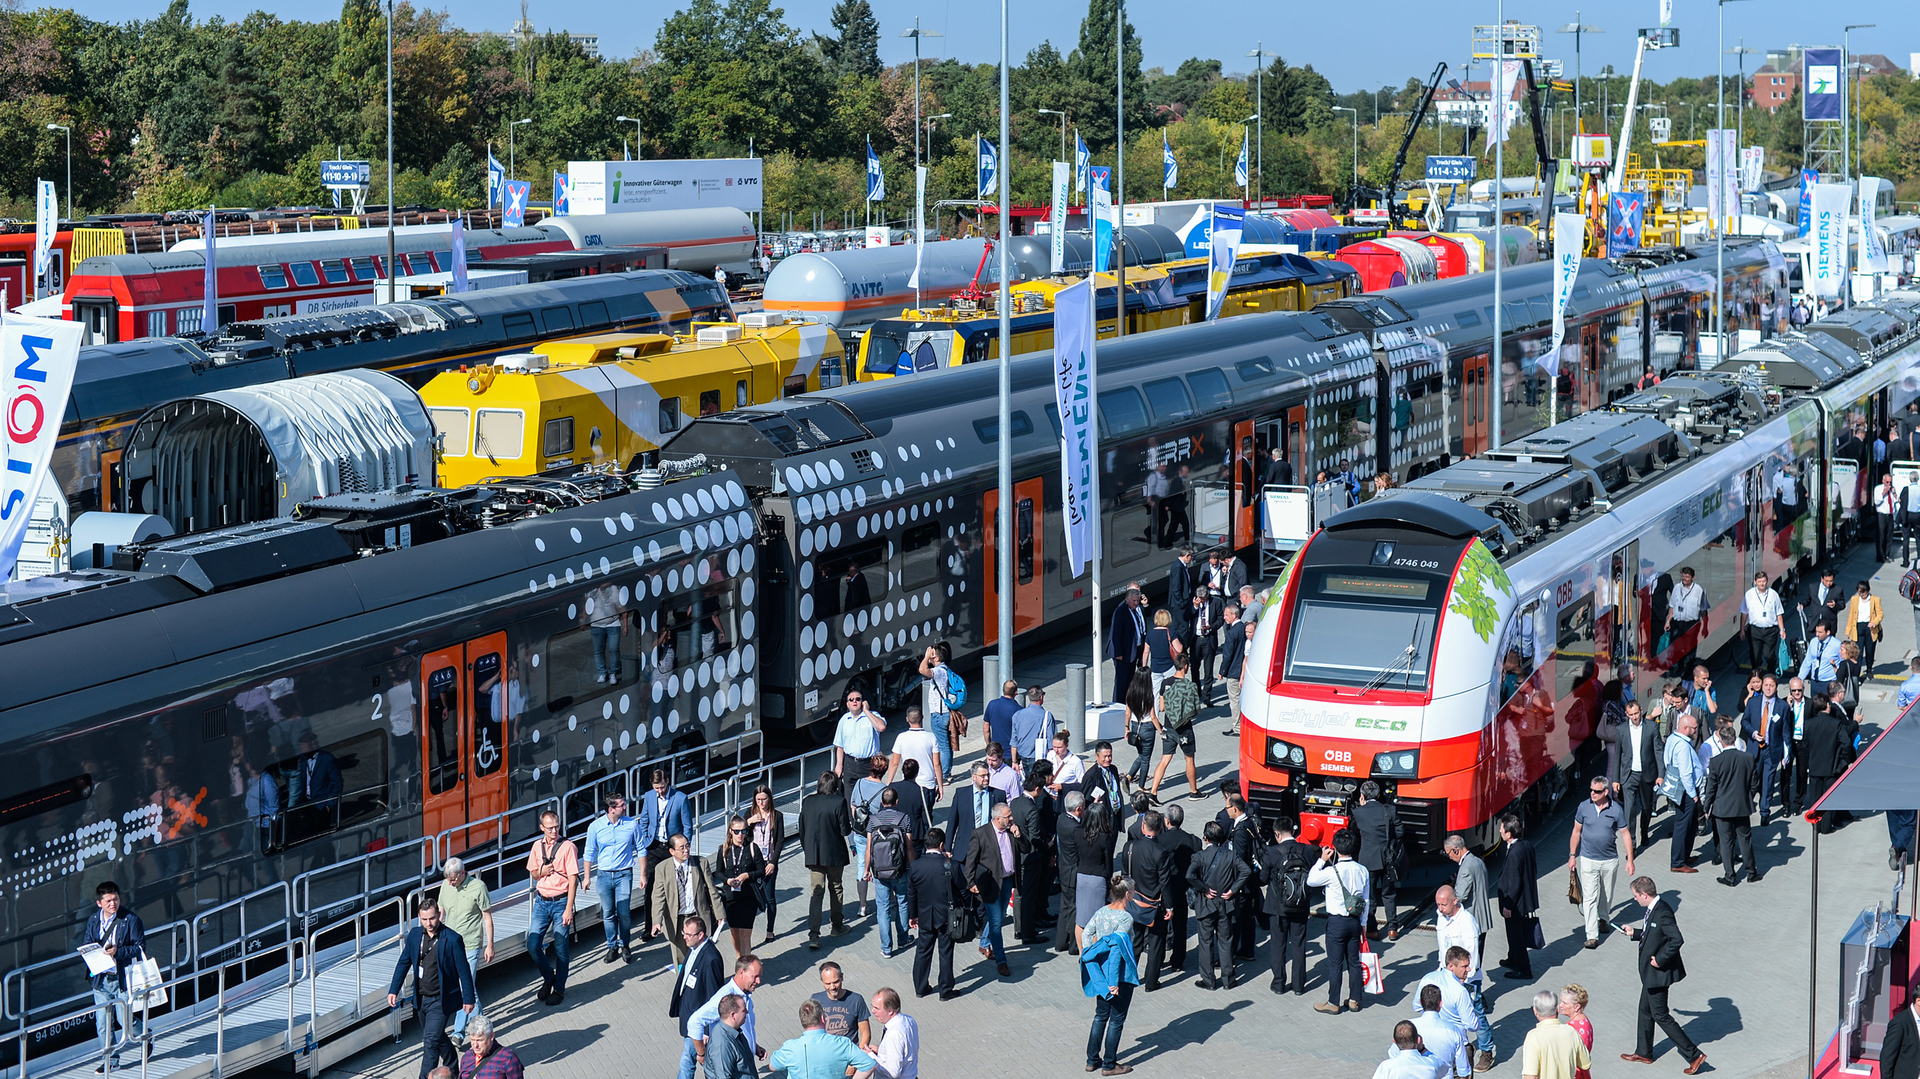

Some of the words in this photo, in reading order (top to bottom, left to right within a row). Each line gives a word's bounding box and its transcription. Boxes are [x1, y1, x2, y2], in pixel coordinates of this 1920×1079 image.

[653, 179, 683, 188] Güterwagen
[744, 178, 758, 186] VTG
[584, 234, 603, 246] GATX
[1818, 210, 1831, 279] SIEMENS
[860, 281, 884, 298] VTG
[307, 302, 320, 314] DB
[321, 298, 359, 312] Sicherheit
[1394, 558, 1419, 568] 4746
[1420, 559, 1439, 570] 049
[1555, 579, 1573, 609] ÖBB
[370, 693, 383, 721] 2
[1278, 708, 1351, 729] cityjet
[1355, 717, 1408, 732] eco
[1324, 749, 1352, 763] ÖBB
[1320, 763, 1355, 774] SIEMENS
[832, 1006, 850, 1015] REAL
[35, 1028, 48, 1043] 94
[49, 1023, 62, 1037] 80
